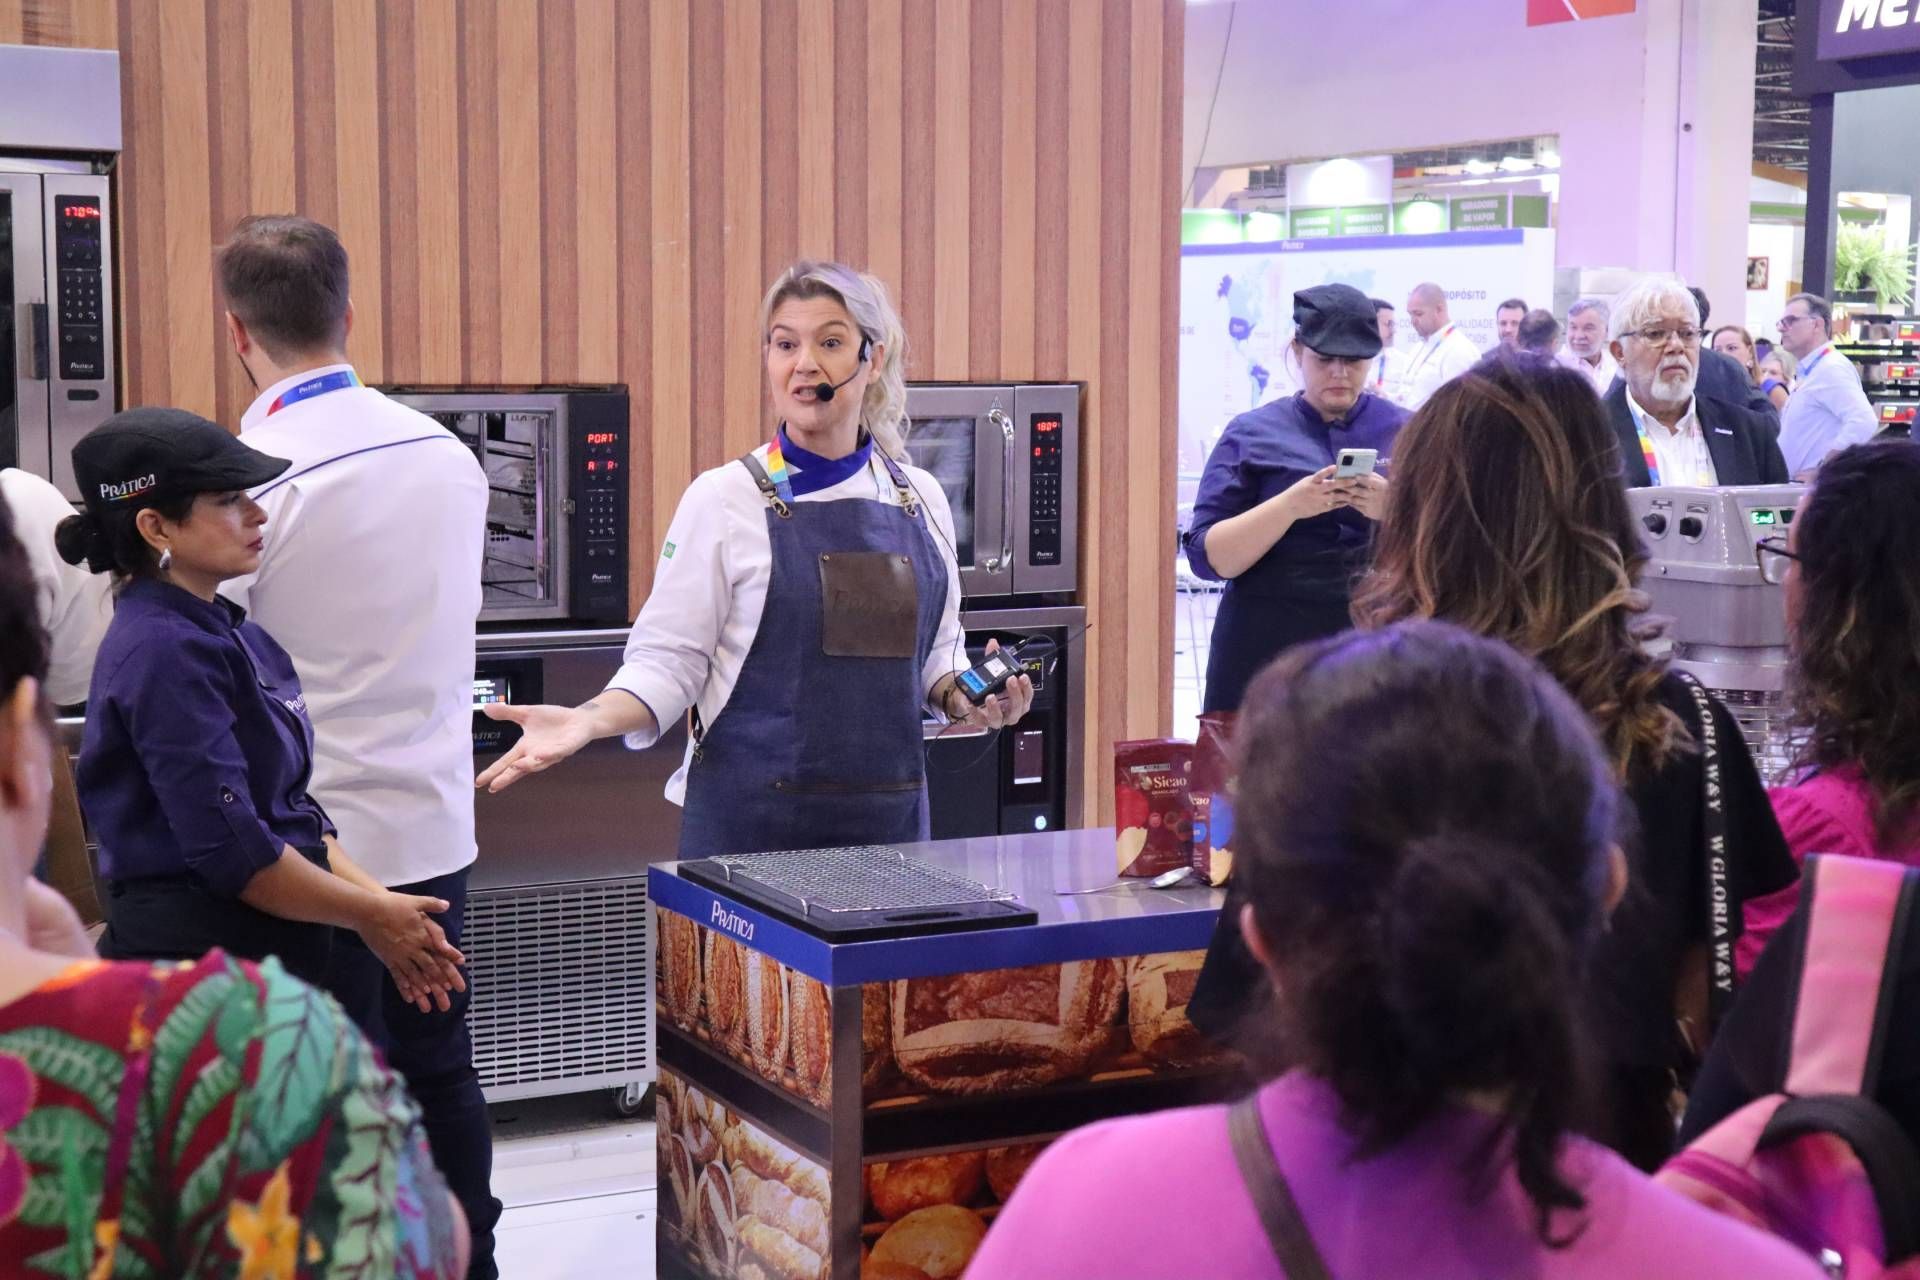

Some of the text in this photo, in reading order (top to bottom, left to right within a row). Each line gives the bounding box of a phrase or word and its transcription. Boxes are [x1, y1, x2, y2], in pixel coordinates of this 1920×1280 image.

[1445, 289, 1486, 300] ROPÓSITO
[587, 433, 613, 444] PORT
[100, 473, 156, 499] PRÁTICA
[1690, 686, 1717, 758] GLORIA
[1153, 775, 1187, 789] Sicao
[1711, 857, 1728, 937] GLORIA
[711, 899, 754, 940] PRÁTICA
